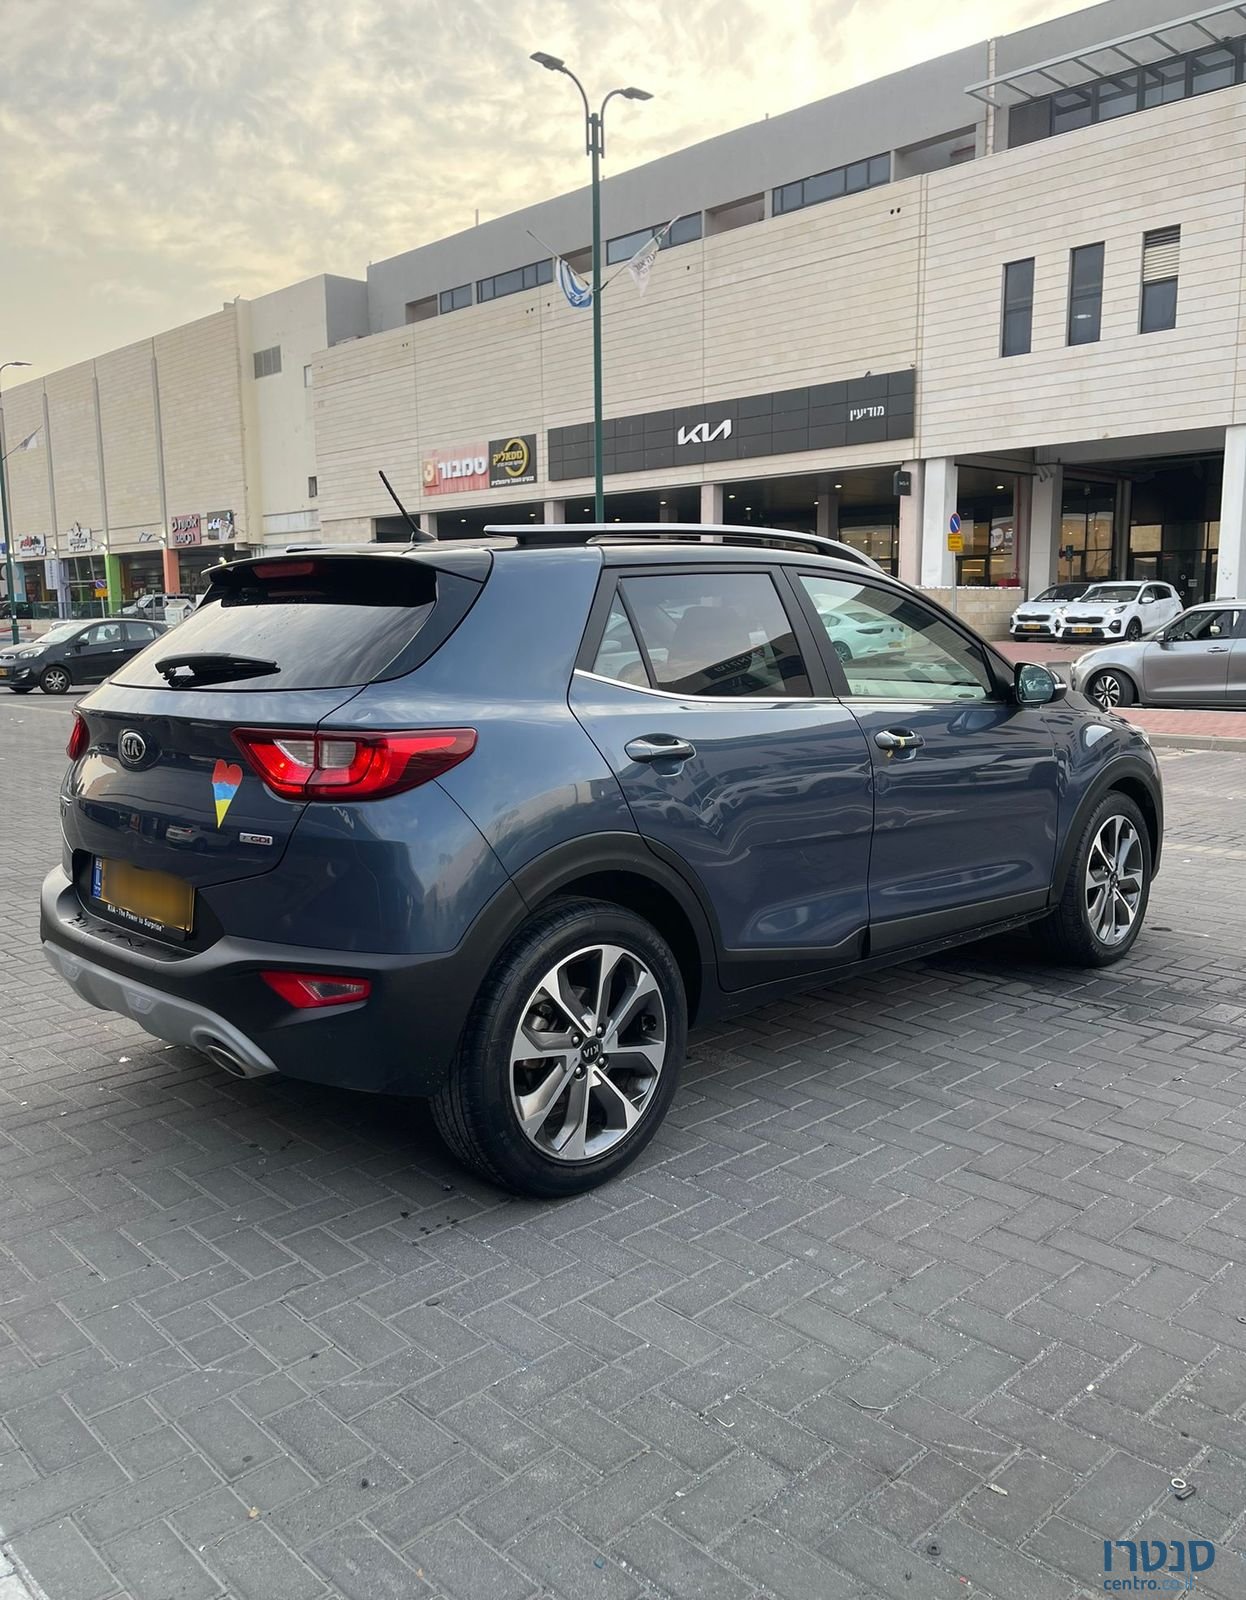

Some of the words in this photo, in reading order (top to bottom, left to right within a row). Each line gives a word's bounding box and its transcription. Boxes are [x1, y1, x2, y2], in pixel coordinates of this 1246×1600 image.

[850, 405, 885, 421] מודיעין
[677, 418, 732, 446] KIA
[438, 456, 487, 479] טמבור
[122, 739, 140, 756] KIA
[107, 904, 116, 914] KIA
[582, 1044, 599, 1058] KIA
